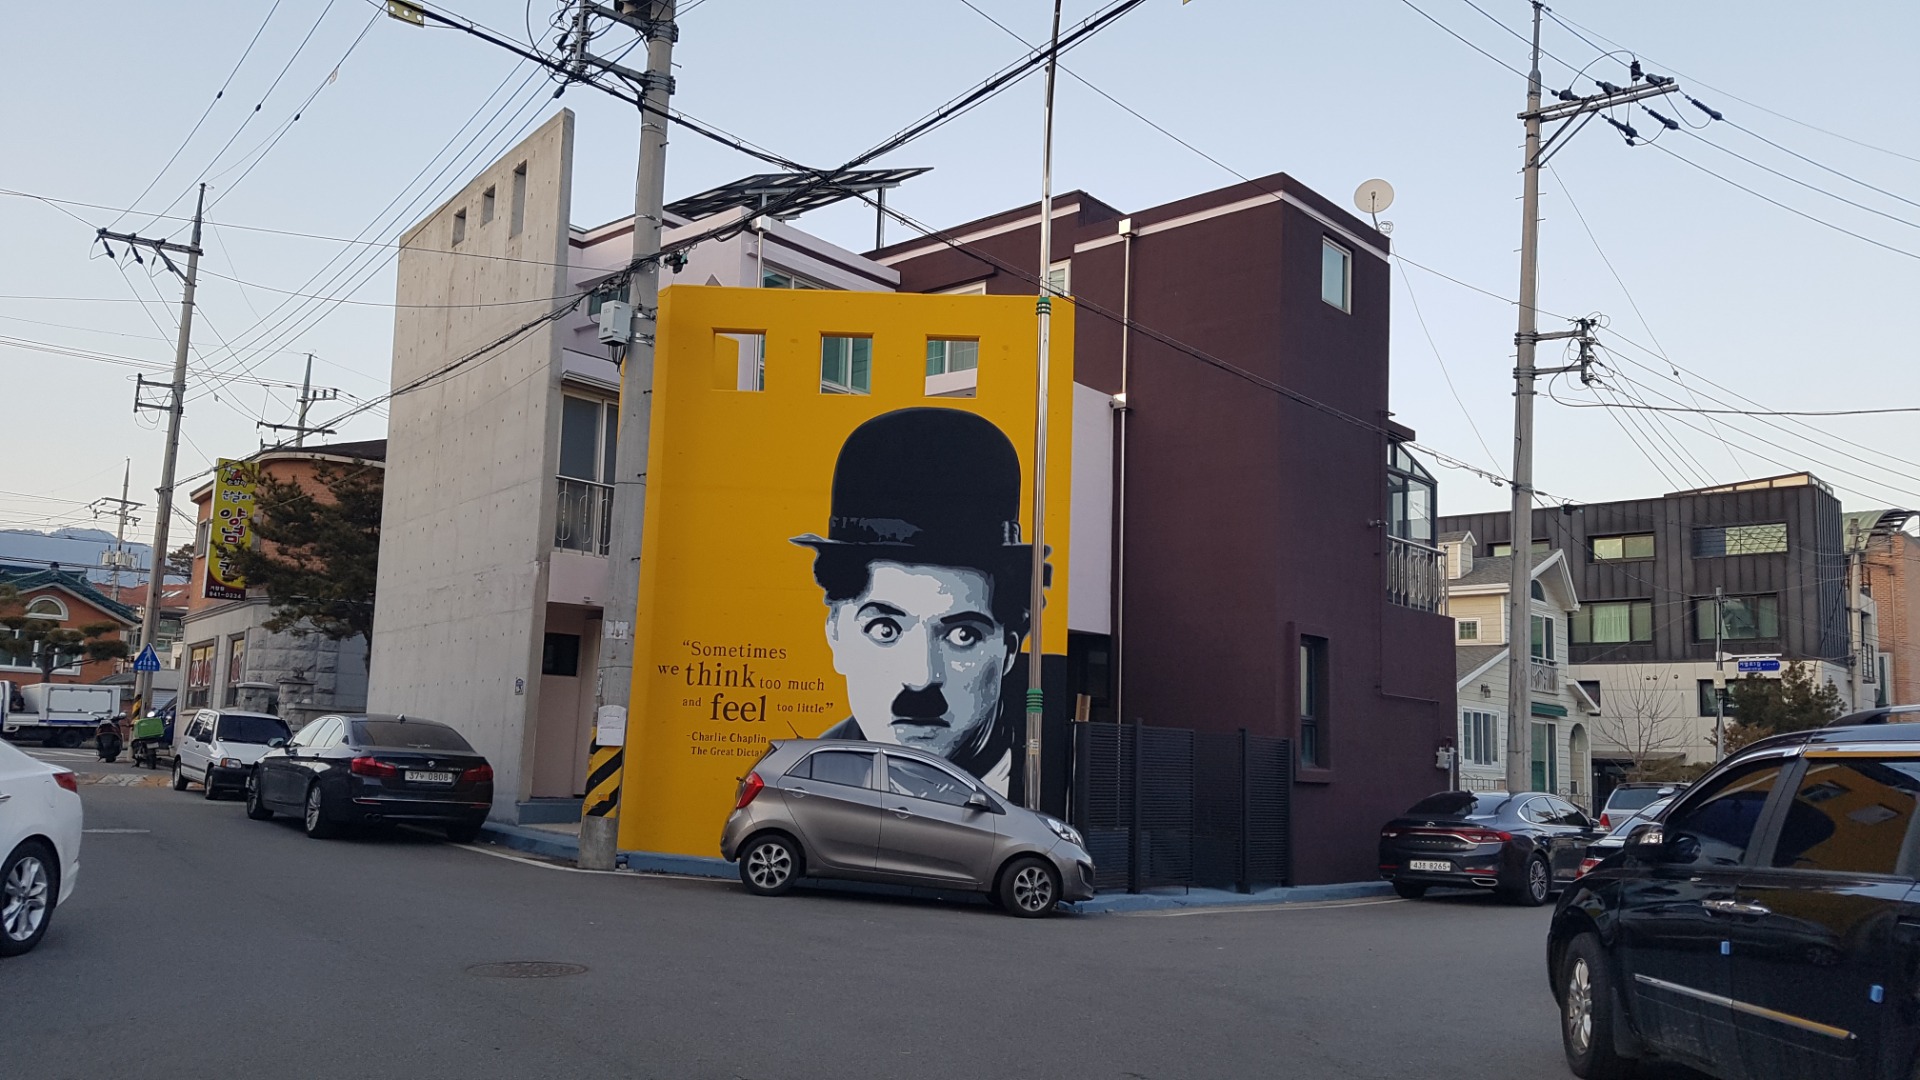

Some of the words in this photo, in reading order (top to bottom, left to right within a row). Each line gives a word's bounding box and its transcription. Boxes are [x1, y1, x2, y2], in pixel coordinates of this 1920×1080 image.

[682, 640, 787, 660] “Sometimes
[658, 664, 680, 676] we
[685, 661, 755, 688] think
[759, 677, 782, 690] too
[788, 678, 825, 691] much
[682, 697, 702, 707] and
[710, 693, 767, 722] feel
[777, 703, 793, 712] too
[797, 702, 834, 714] little”
[729, 732, 767, 744] Chaplin
[691, 746, 708, 755] The
[710, 747, 734, 756] Great
[428, 772, 449, 781] 0808
[1429, 862, 1447, 870] 8265
